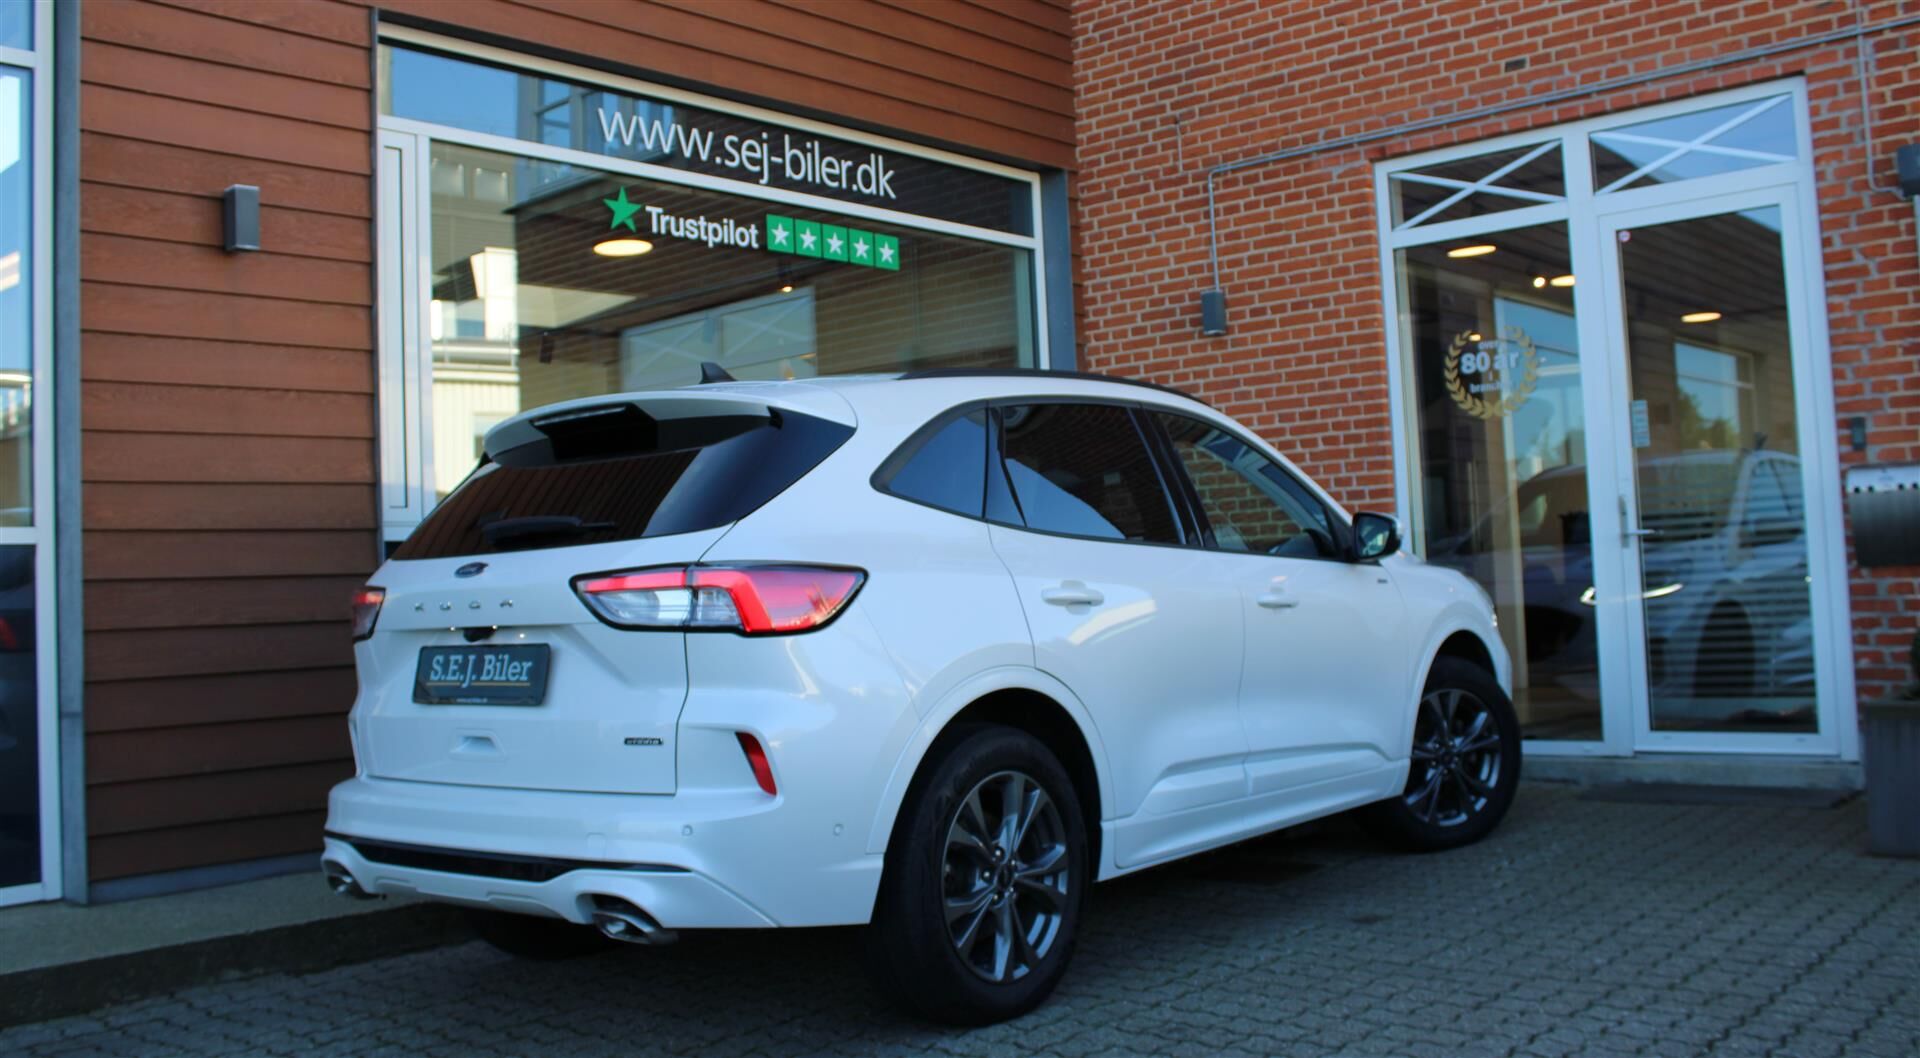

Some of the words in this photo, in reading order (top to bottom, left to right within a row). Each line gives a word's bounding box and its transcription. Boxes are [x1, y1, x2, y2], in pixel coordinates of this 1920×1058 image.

[597, 107, 897, 200] www.sej-biler.dk
[645, 205, 759, 248] Trustpilot
[1460, 351, 1491, 374] 80
[414, 599, 513, 612] KUGA
[430, 653, 477, 688] S.E.J.
[480, 653, 533, 682] Biler
